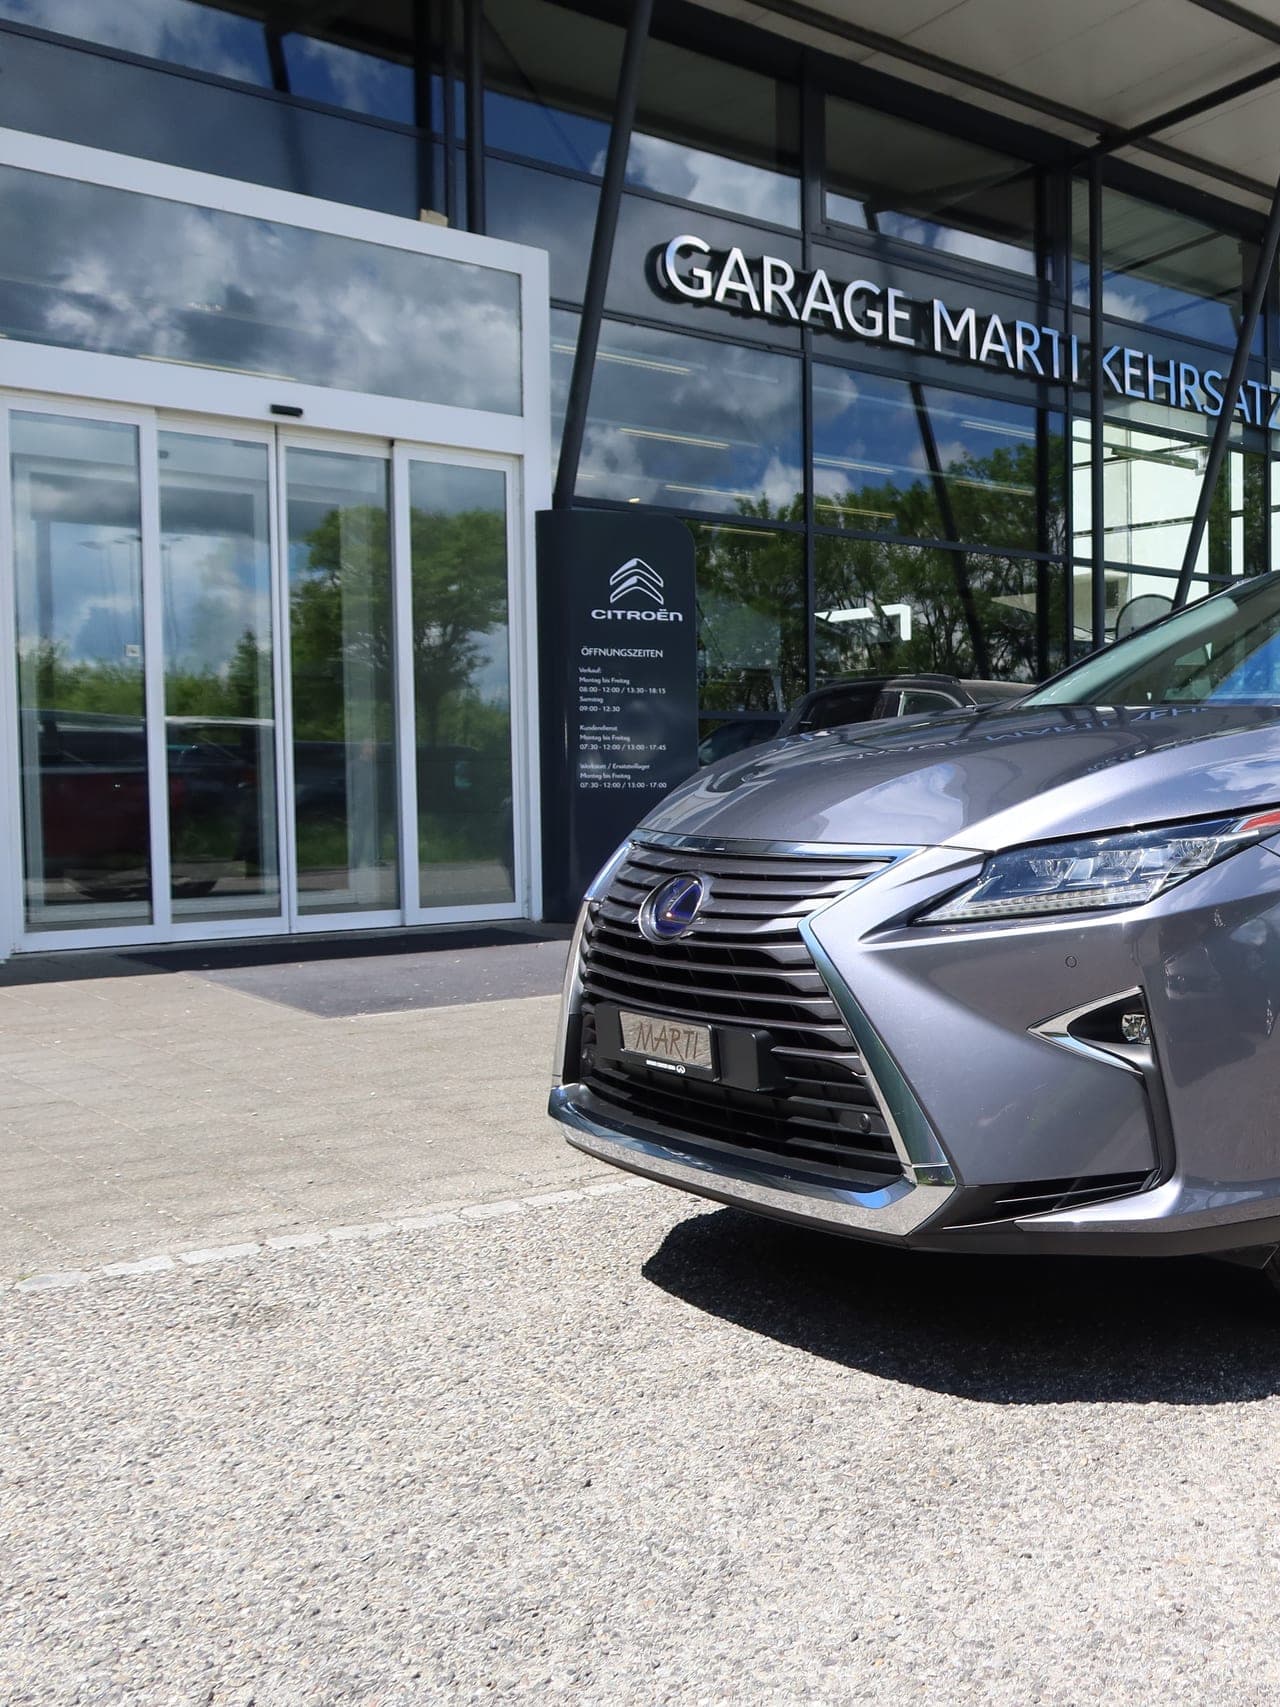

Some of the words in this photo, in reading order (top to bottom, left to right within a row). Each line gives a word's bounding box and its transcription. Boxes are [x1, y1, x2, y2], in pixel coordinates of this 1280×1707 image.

[665, 234, 916, 347] GARAGE
[932, 298, 1079, 383] MARTI
[580, 646, 664, 658] ÖFFNUNGSZEITEN
[635, 1021, 703, 1061] MARTI
